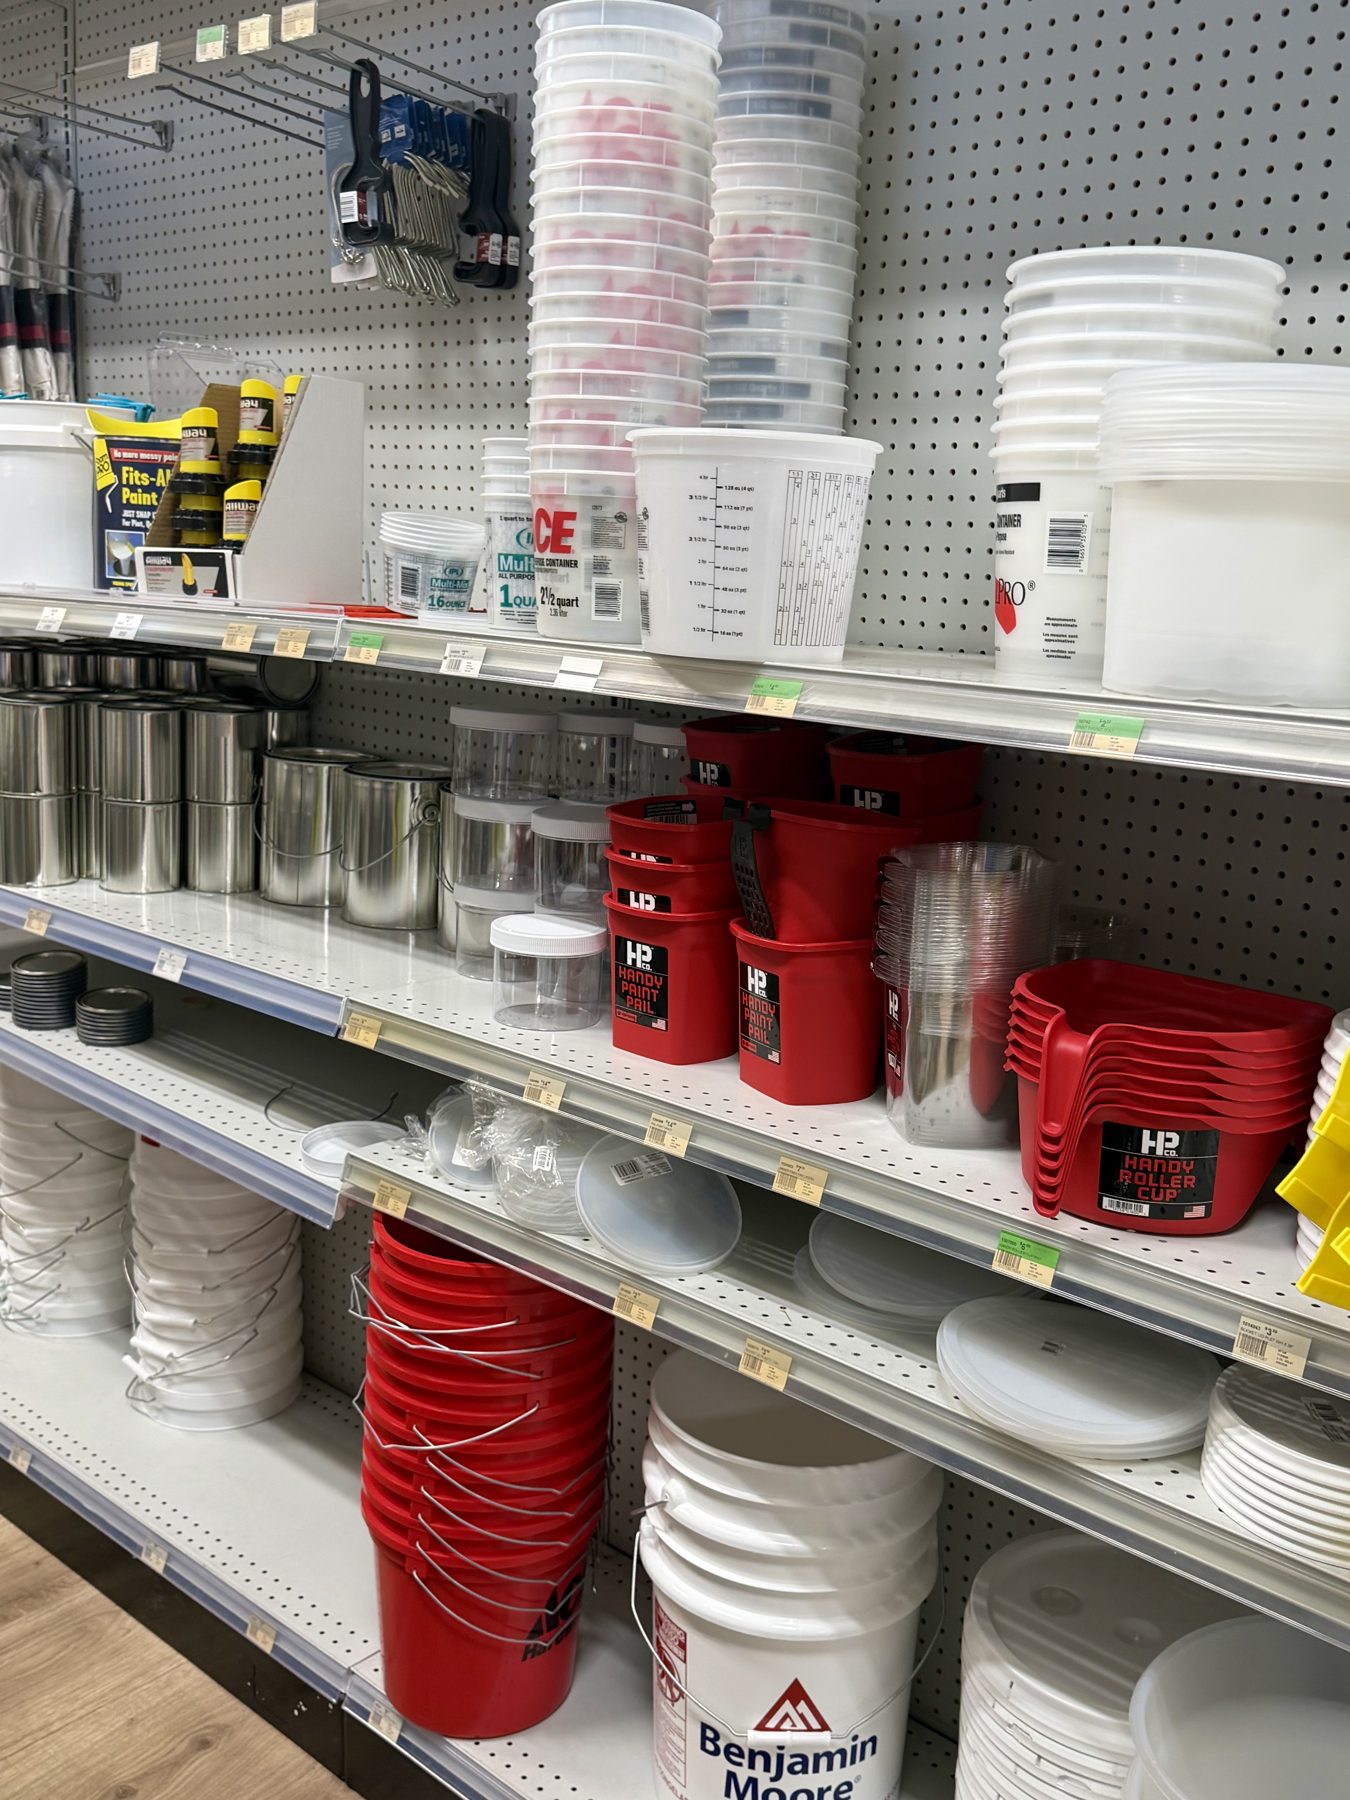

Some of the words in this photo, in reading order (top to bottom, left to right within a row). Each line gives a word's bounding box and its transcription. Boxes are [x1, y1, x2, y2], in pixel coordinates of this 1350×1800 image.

[140, 452, 161, 463] messy
[122, 487, 158, 506] Paint
[145, 556, 172, 565] Allway
[546, 558, 578, 569] CONTAINER
[429, 594, 446, 608] 16
[499, 583, 513, 608] 1
[556, 596, 579, 608] quart
[699, 761, 720, 785] HP
[626, 940, 653, 968] HP
[618, 966, 663, 988] HANDY
[747, 965, 767, 995] HP
[621, 980, 659, 1002] PAINT
[626, 996, 654, 1015] PAIL
[742, 991, 776, 1017] HANDY
[744, 1007, 773, 1031] PAINT
[748, 1023, 769, 1044] PAIL
[1141, 1129, 1180, 1156] HP
[1163, 1149, 1179, 1157] CO.
[1124, 1155, 1195, 1174] HANDY
[1119, 1169, 1196, 1189] ROLLER
[1137, 1187, 1178, 1202] CUP
[700, 1721, 878, 1782] Benjamin
